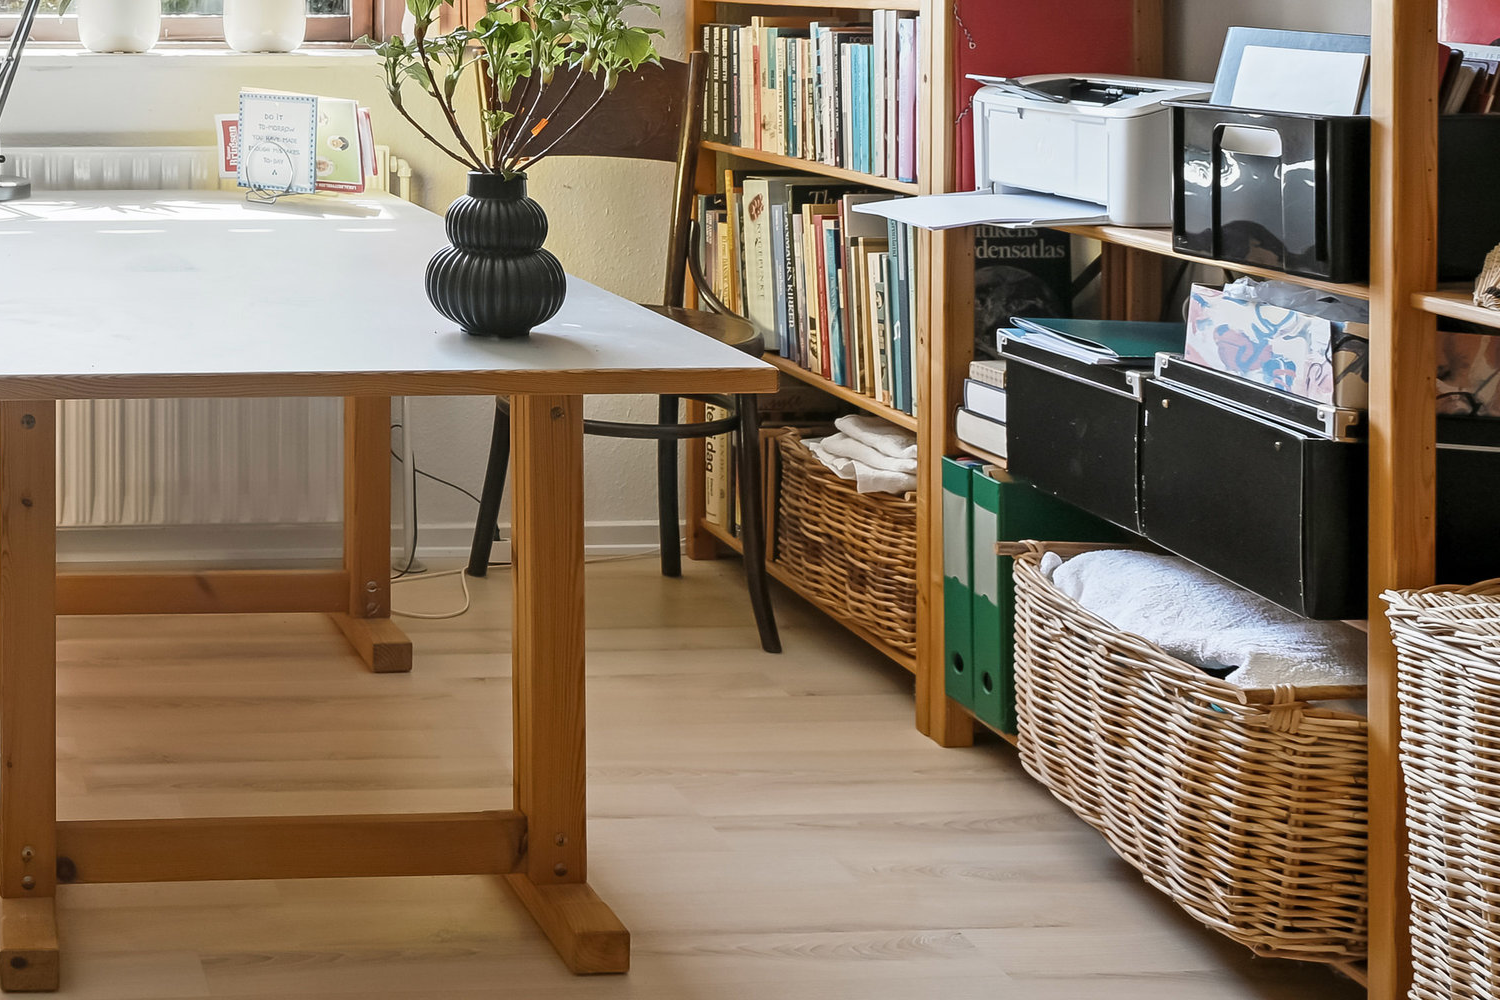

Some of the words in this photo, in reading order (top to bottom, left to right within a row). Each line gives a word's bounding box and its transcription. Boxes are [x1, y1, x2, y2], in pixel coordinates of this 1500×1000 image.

[975, 238, 1065, 258] densatlas
[787, 284, 795, 328] KIRKER
[705, 442, 716, 473] dag
